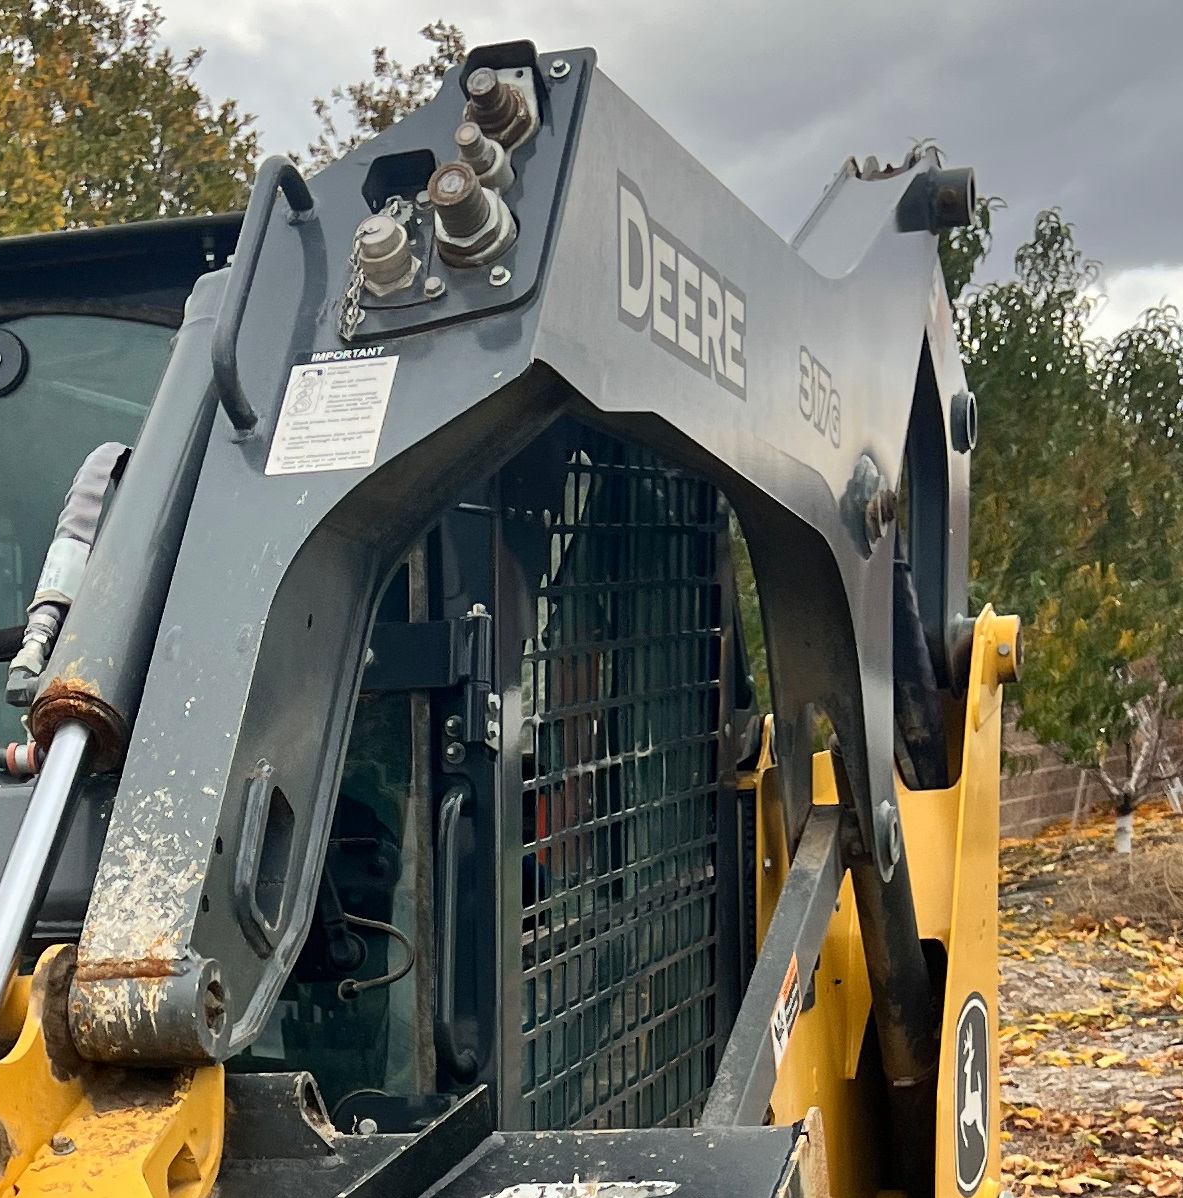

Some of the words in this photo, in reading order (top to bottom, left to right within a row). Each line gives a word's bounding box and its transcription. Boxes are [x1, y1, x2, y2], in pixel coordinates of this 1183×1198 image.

[619, 184, 746, 391] DEERE
[311, 347, 384, 361] IMPORTANT
[799, 344, 841, 449] 317G
